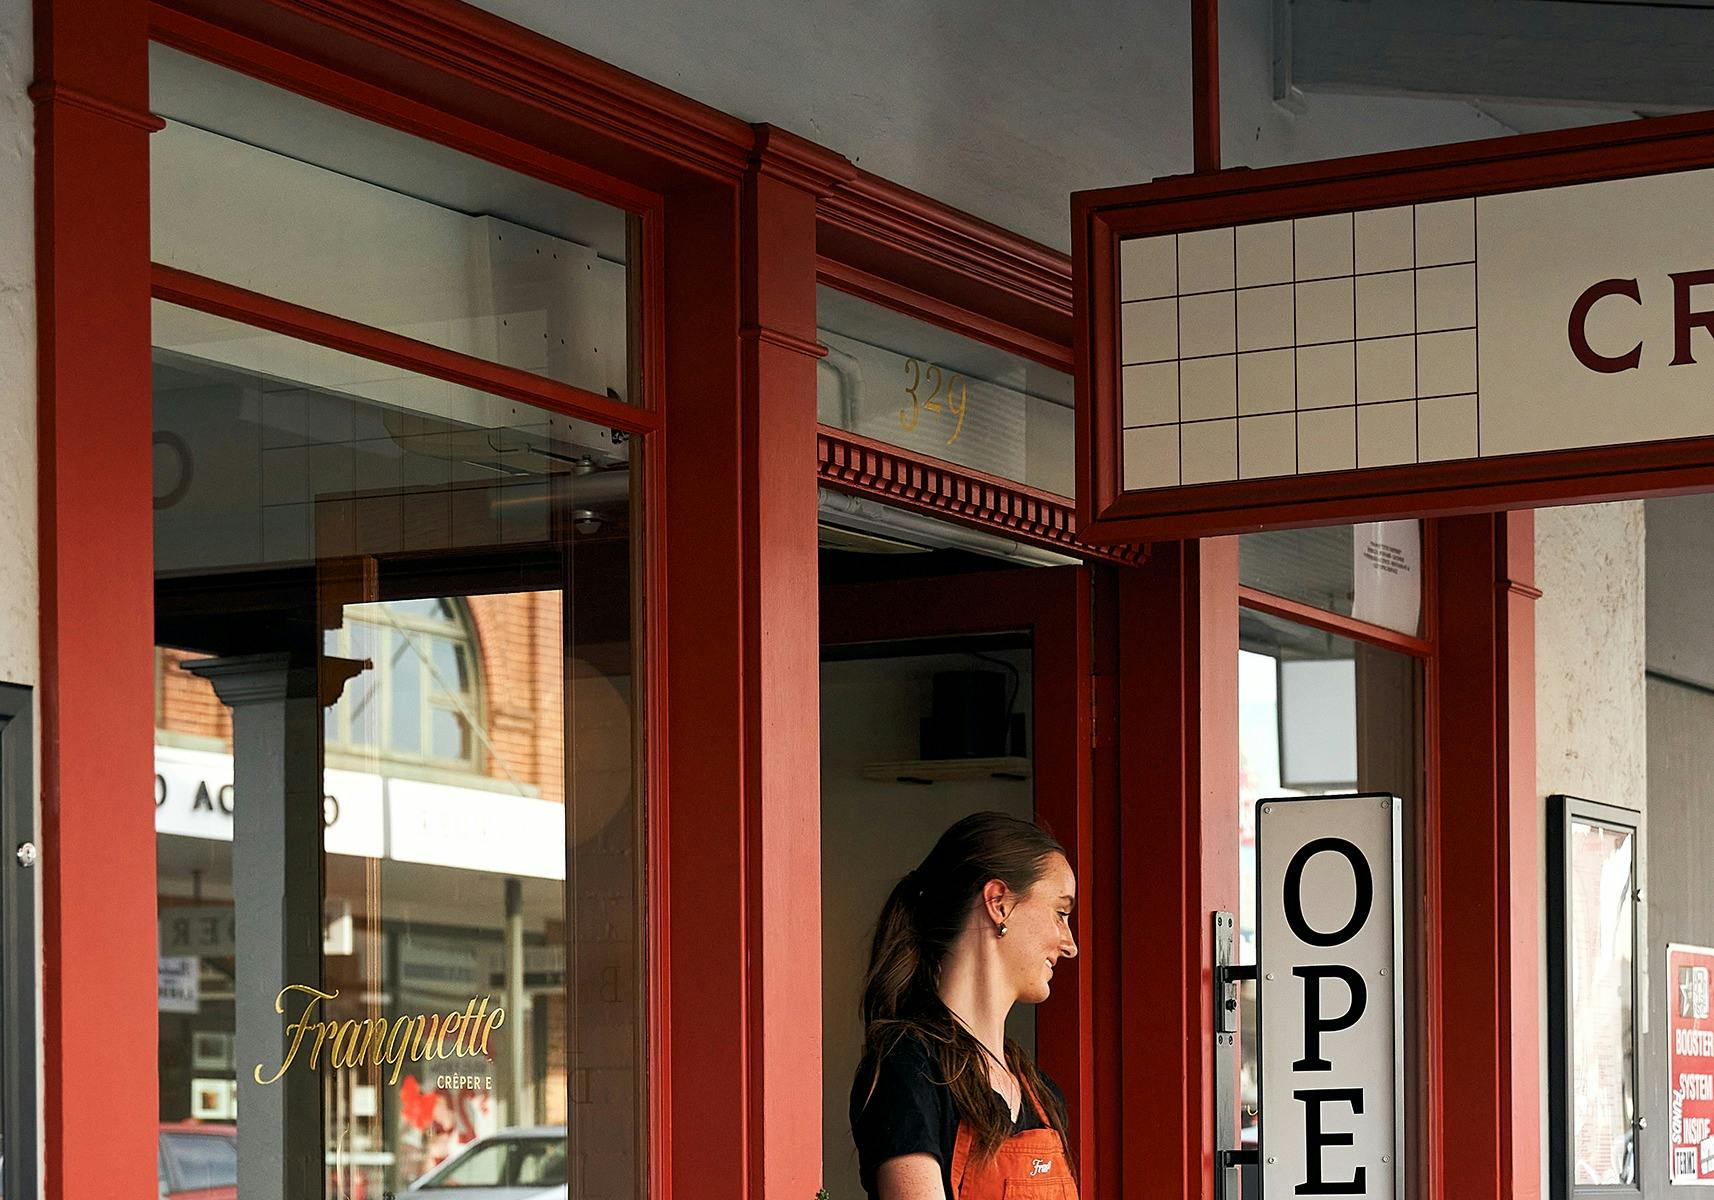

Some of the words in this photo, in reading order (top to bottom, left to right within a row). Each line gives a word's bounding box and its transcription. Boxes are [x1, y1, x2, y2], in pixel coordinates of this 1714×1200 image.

[1568, 269, 1714, 373] CR
[898, 358, 967, 445] 329
[254, 984, 505, 1086] Franquette
[1676, 1028, 1714, 1057] BOOSTER
[436, 1072, 493, 1090] CRÊPERE
[1679, 1072, 1713, 1101] SYSTEM
